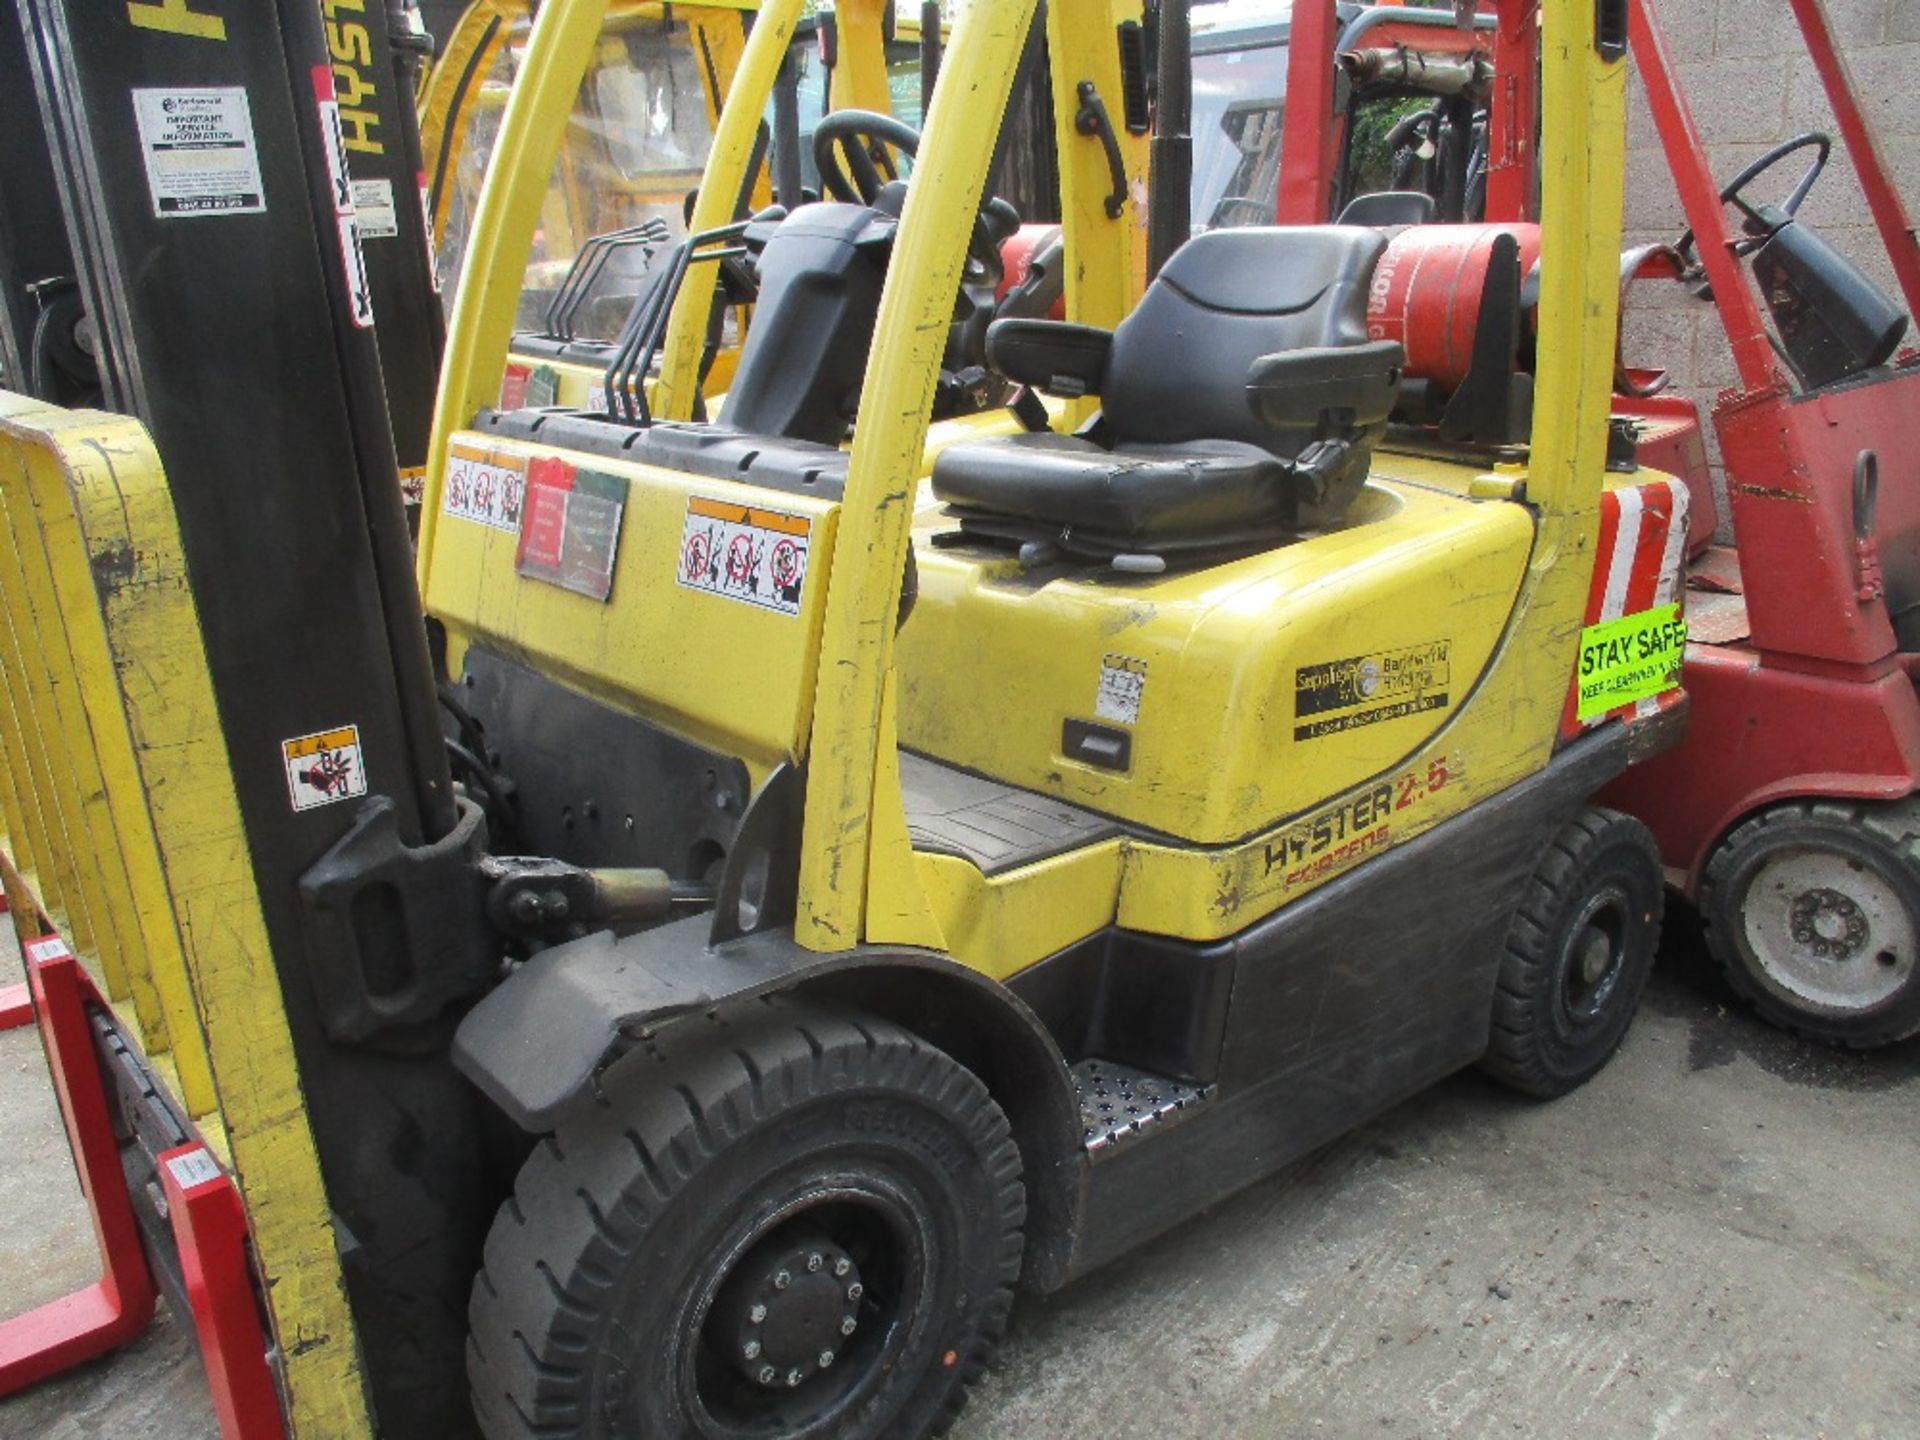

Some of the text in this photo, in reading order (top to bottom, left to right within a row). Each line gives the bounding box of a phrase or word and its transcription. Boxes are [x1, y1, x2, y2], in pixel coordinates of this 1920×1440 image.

[1581, 620, 1685, 677] STAY SAFE
[1264, 755, 1448, 877] HYSTER 2.5
